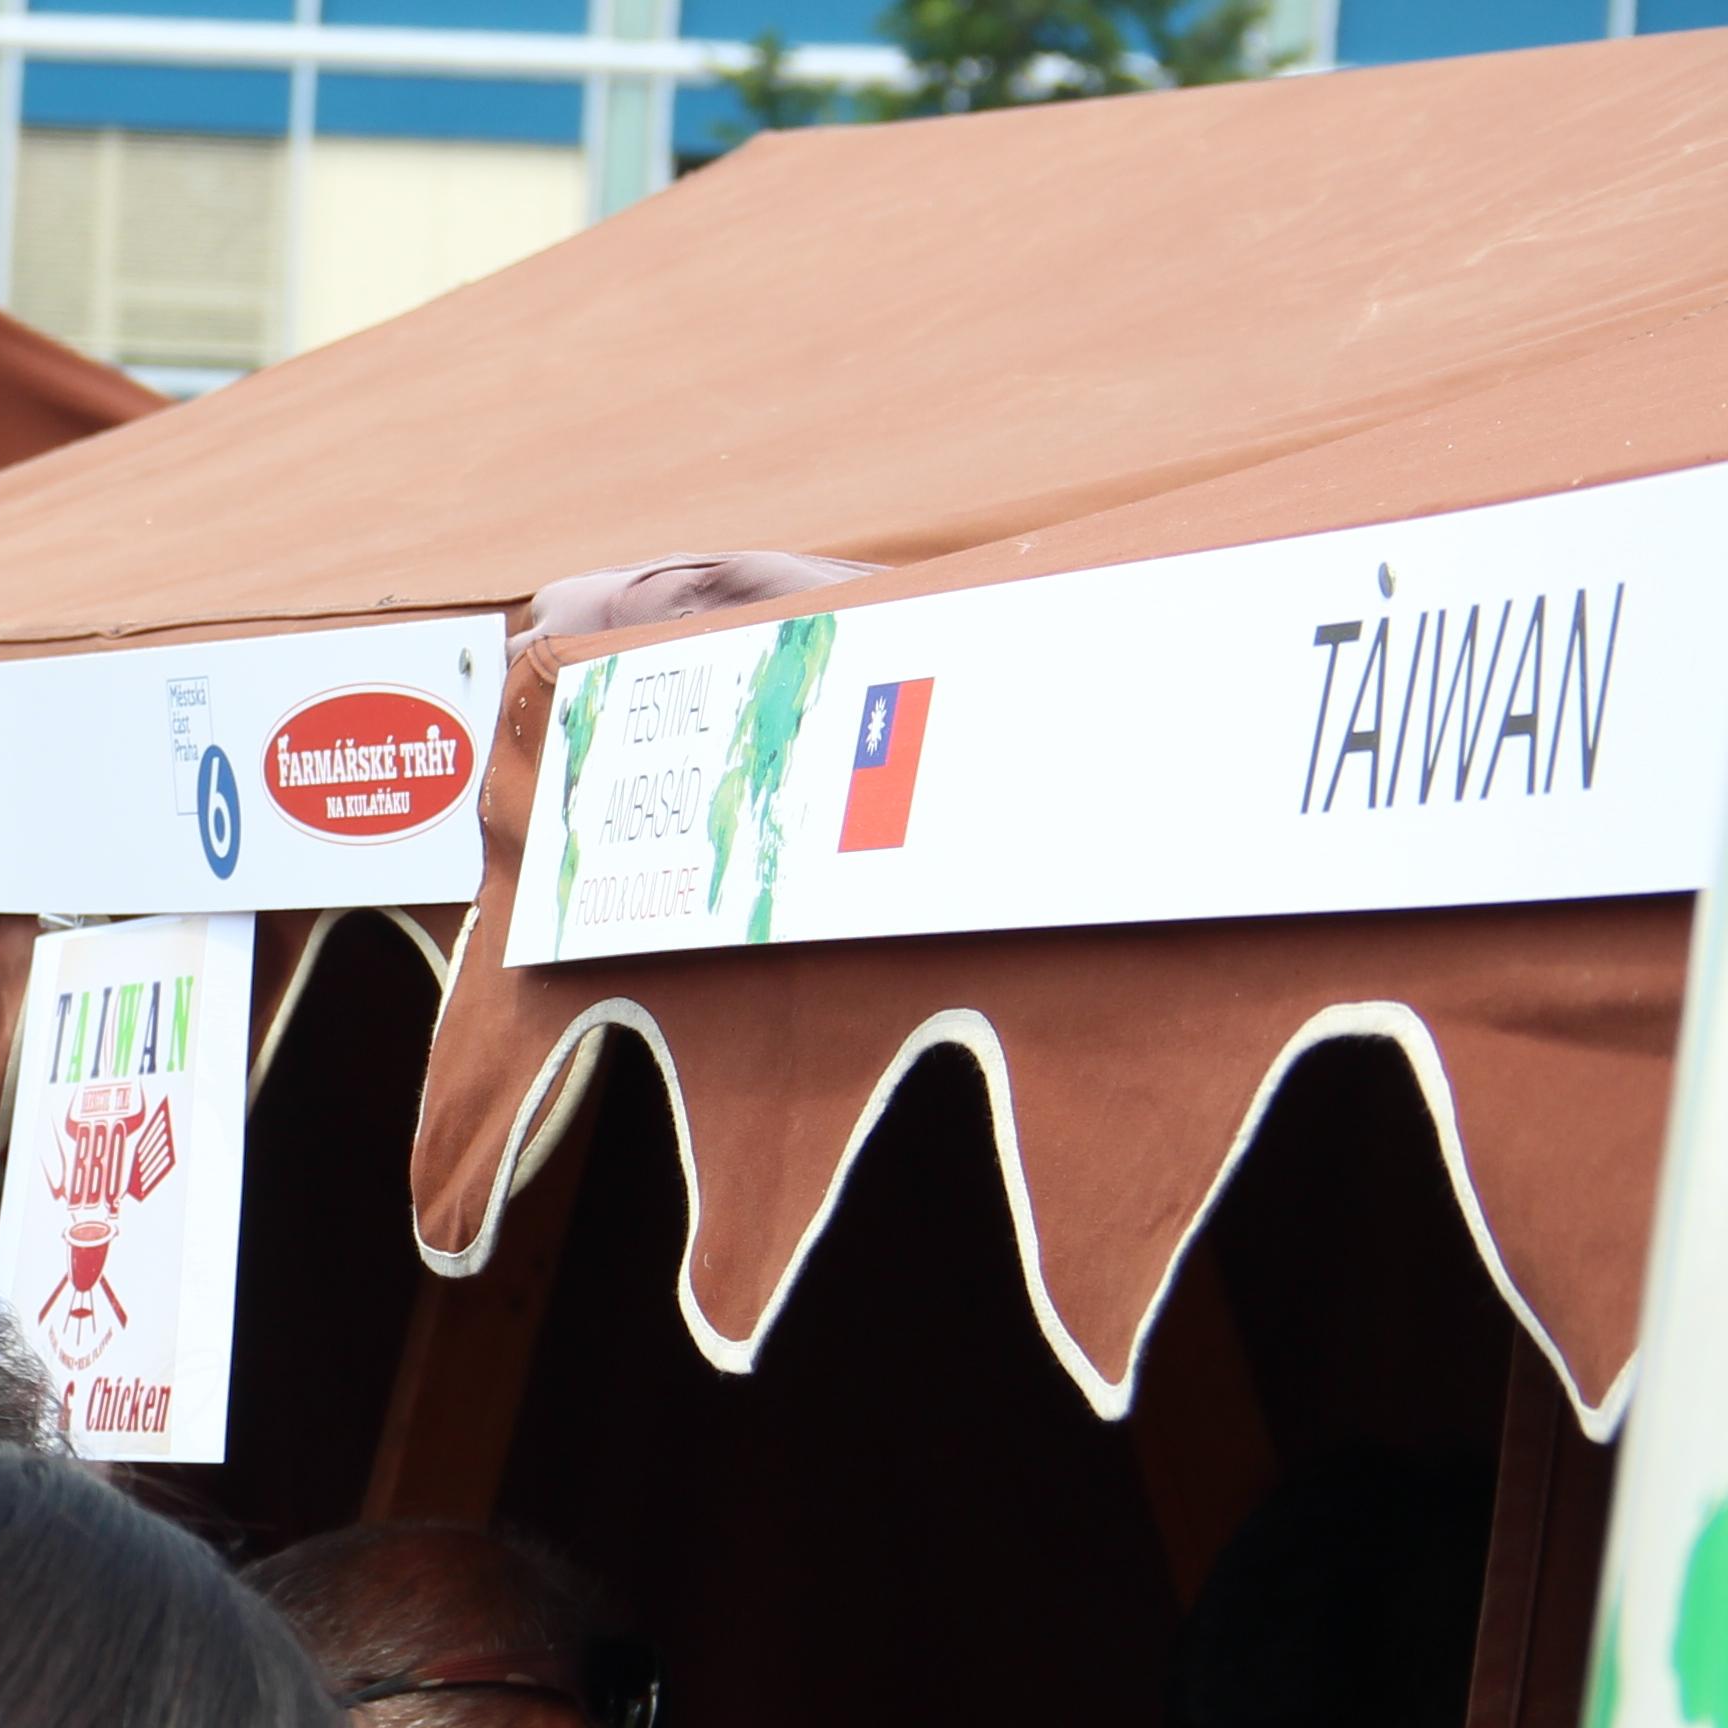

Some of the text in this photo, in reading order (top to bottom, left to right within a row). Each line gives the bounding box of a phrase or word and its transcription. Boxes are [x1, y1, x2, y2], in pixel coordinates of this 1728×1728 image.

[623, 664, 713, 745] FESTIVAL
[1300, 582, 1625, 814] TAIWAN
[174, 739, 199, 762] Praha
[277, 735, 456, 787] FARMÁŘSKÉ TRHY
[207, 757, 232, 858] 6
[326, 788, 410, 818] NA KULAŤÁKU
[600, 755, 702, 845] AMBASÁD
[576, 867, 700, 926] FOOD & CULTURE
[49, 975, 194, 1084] TAIWAN
[69, 1121, 127, 1215] BBQ
[86, 1376, 171, 1433] Chicken
